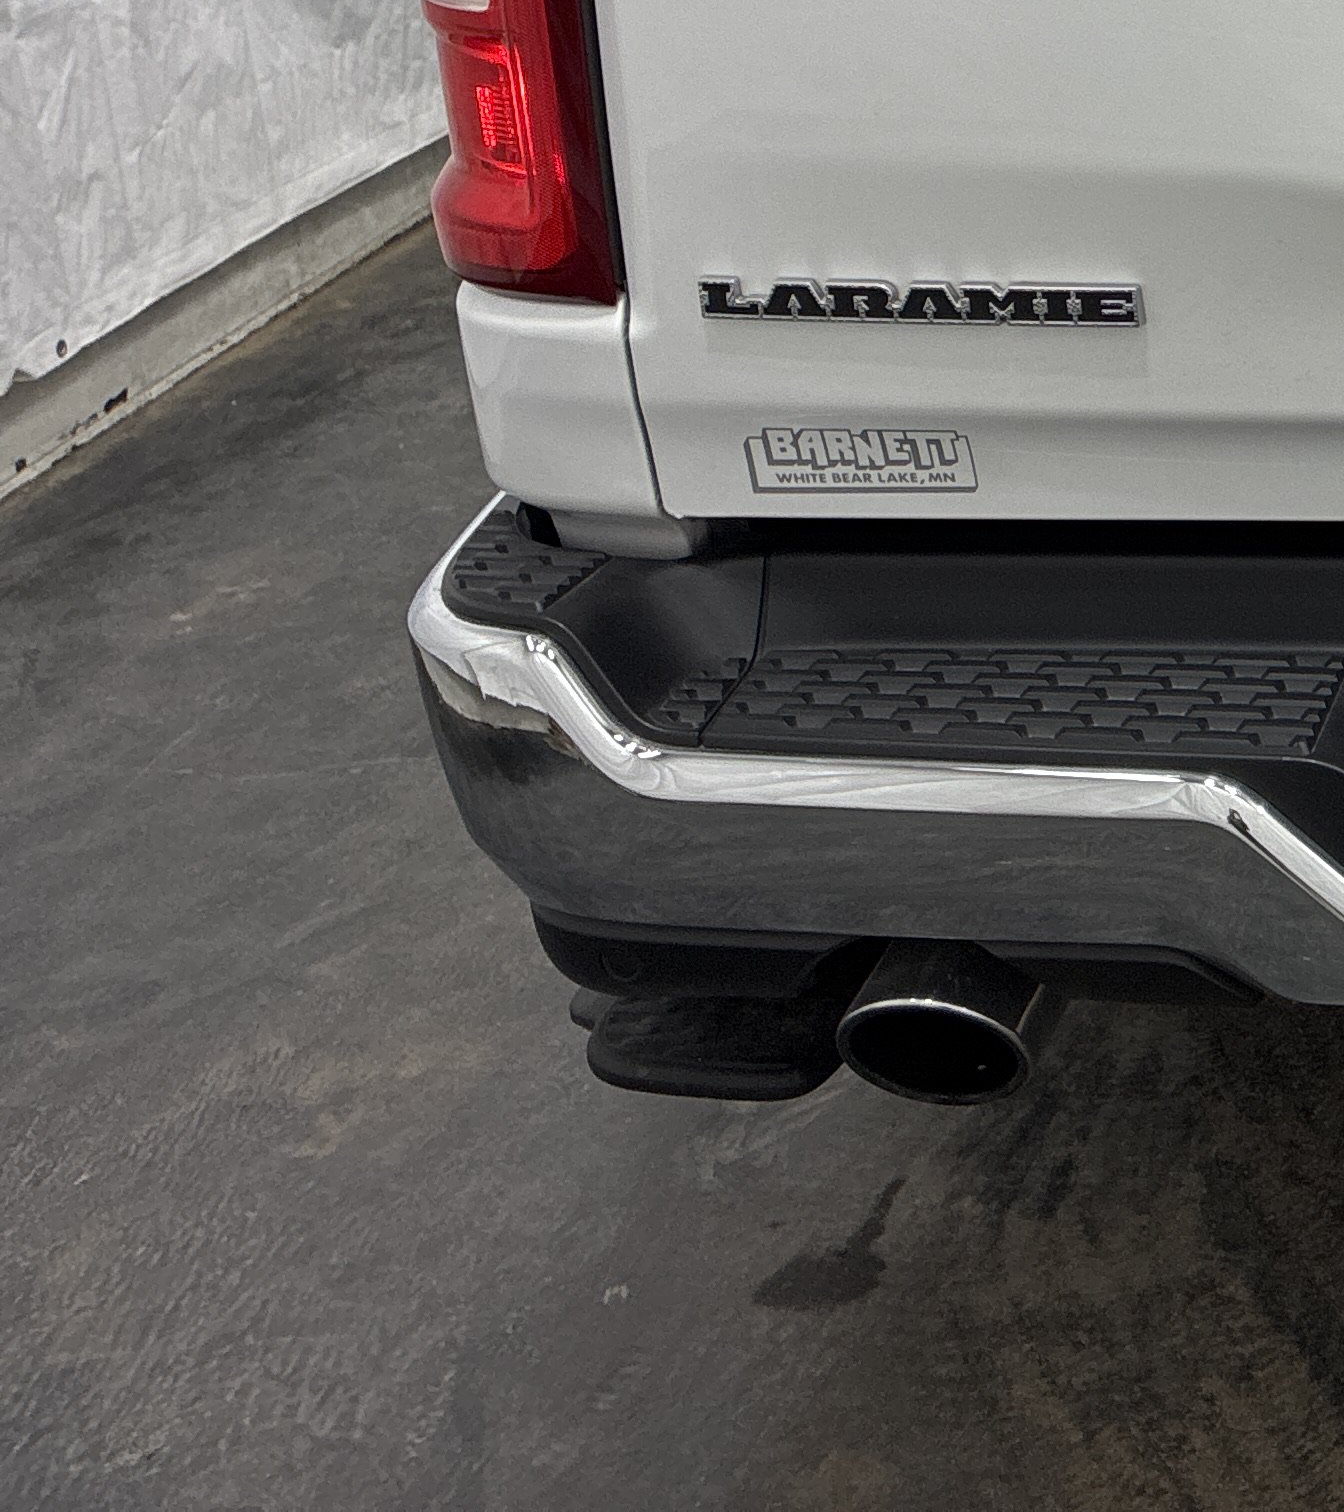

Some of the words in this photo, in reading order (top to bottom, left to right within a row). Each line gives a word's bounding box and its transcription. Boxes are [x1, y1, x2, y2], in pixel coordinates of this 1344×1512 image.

[699, 275, 1145, 327] LARAMIE
[761, 428, 959, 470] BARNETT
[775, 472, 827, 484] WHITE
[832, 472, 872, 484] BEAR
[878, 472, 925, 485] LAKE,
[928, 472, 956, 483] MN
